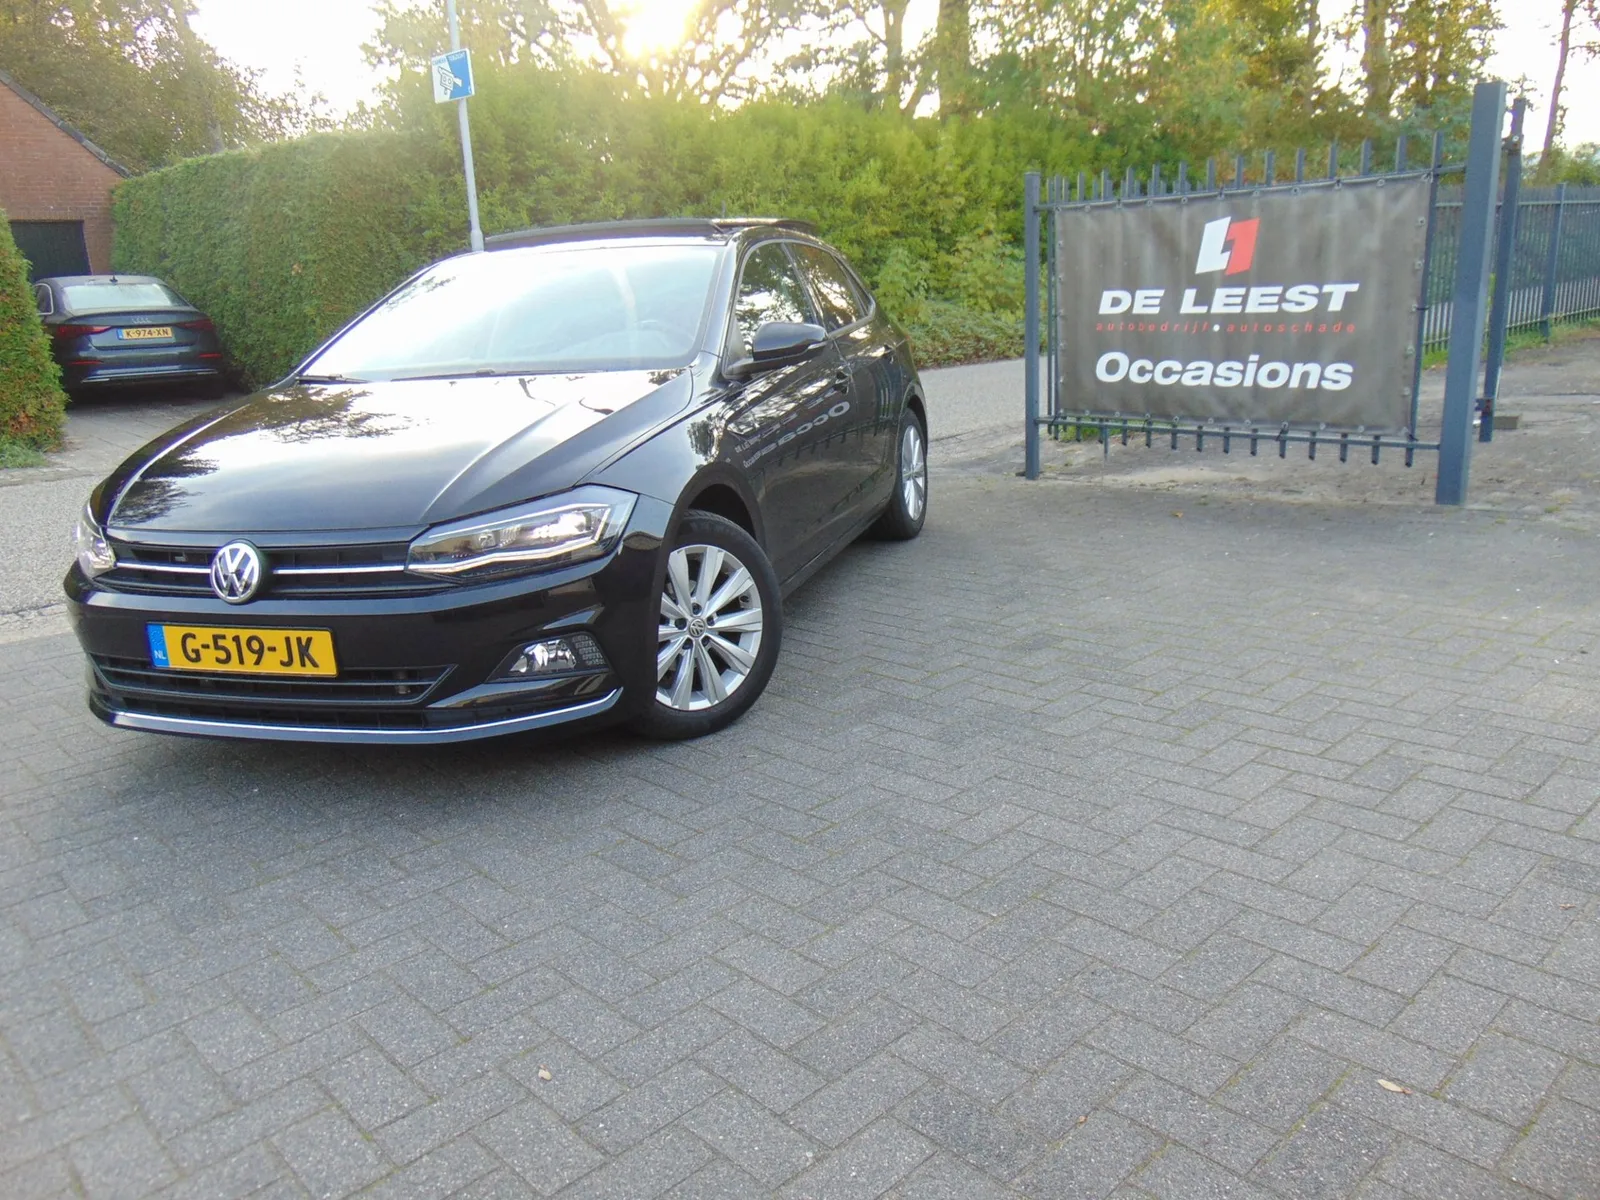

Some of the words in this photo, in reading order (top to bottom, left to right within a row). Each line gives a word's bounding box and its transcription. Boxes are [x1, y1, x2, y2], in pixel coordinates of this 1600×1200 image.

[1098, 289, 1165, 315] DE
[1180, 283, 1360, 314] LEEST
[125, 329, 169, 338] K-974-XN
[1226, 322, 1356, 333] autoschade
[1095, 351, 1355, 391] Occasions
[181, 632, 320, 668] G-519-JK
